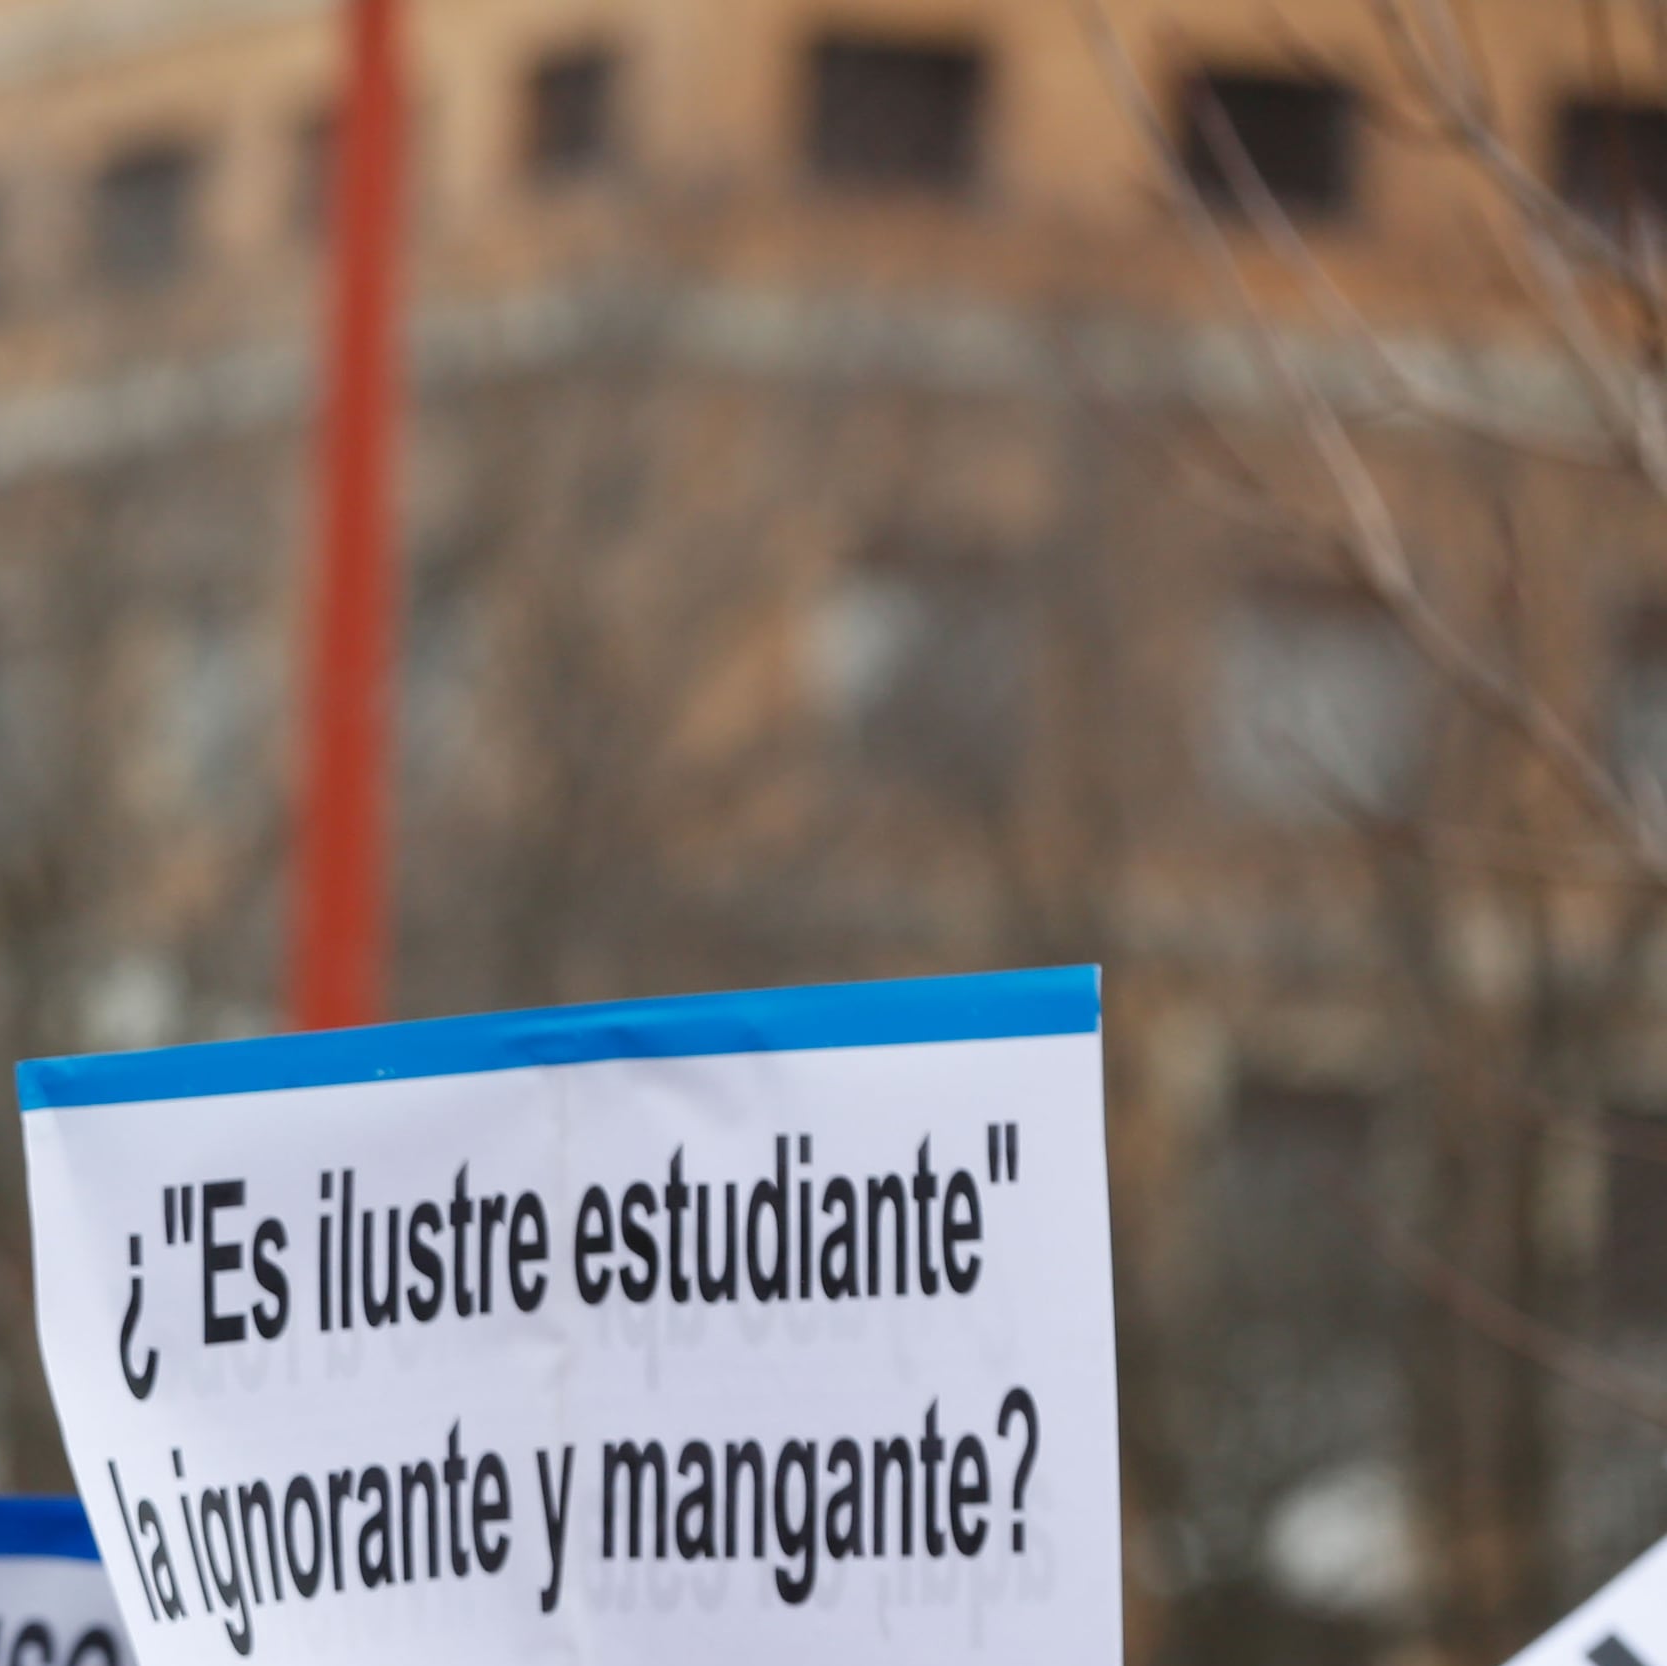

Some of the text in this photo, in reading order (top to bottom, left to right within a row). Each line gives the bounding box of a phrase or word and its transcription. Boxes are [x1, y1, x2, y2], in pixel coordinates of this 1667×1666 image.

[317, 1169, 549, 1333] ilustre
[571, 1120, 1021, 1307] estudiante"
[105, 1386, 1040, 1660] la ignorante y mangante?
